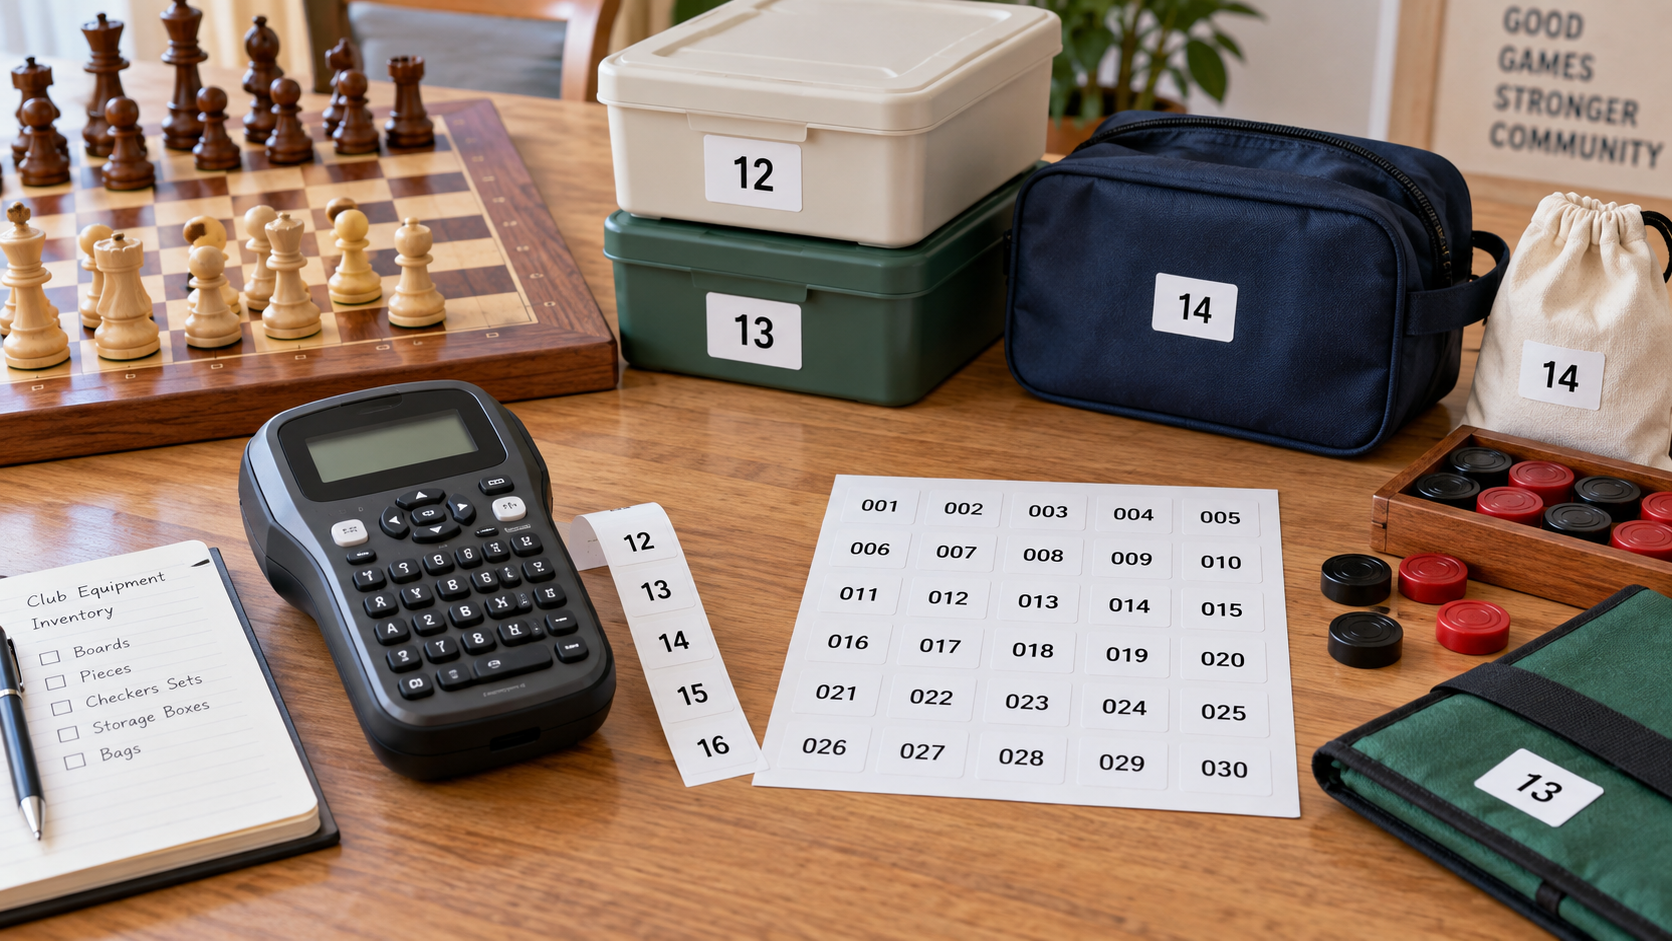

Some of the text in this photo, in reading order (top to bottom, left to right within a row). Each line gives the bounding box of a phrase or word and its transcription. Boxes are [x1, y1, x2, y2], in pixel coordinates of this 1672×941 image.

[1502, 5, 1585, 40] GOOD
[1498, 45, 1596, 83] GAMES
[1493, 82, 1640, 129] STRONGER
[1489, 120, 1664, 170] COMMUNITY
[734, 155, 774, 192] 12
[1178, 292, 1212, 324] 14
[734, 313, 774, 350] 13
[1542, 360, 1579, 393] 14
[862, 499, 1241, 525] 001 002 003 004 005
[623, 531, 655, 552] 12
[850, 541, 1242, 570] 006 007 008 009 010
[27, 571, 166, 608] Club Equipment
[640, 579, 672, 601] 13
[839, 586, 1243, 618] 011 012 013 014 015
[32, 606, 114, 631] Inventory
[387, 622, 399, 634] A
[73, 637, 131, 659] Boards
[658, 630, 690, 653] 14
[827, 634, 1245, 668] 016 017 018 019 020
[79, 664, 132, 683] Pieces
[85, 674, 203, 708] Checkers Sets
[676, 682, 709, 706] 15
[815, 684, 1247, 721] 021 022 023 024 025
[92, 700, 210, 735] Storage Boxes
[99, 744, 142, 762] Bags
[697, 735, 730, 758] 16
[802, 737, 1248, 779] 026 027 028 029 030
[1516, 773, 1563, 803] 13
